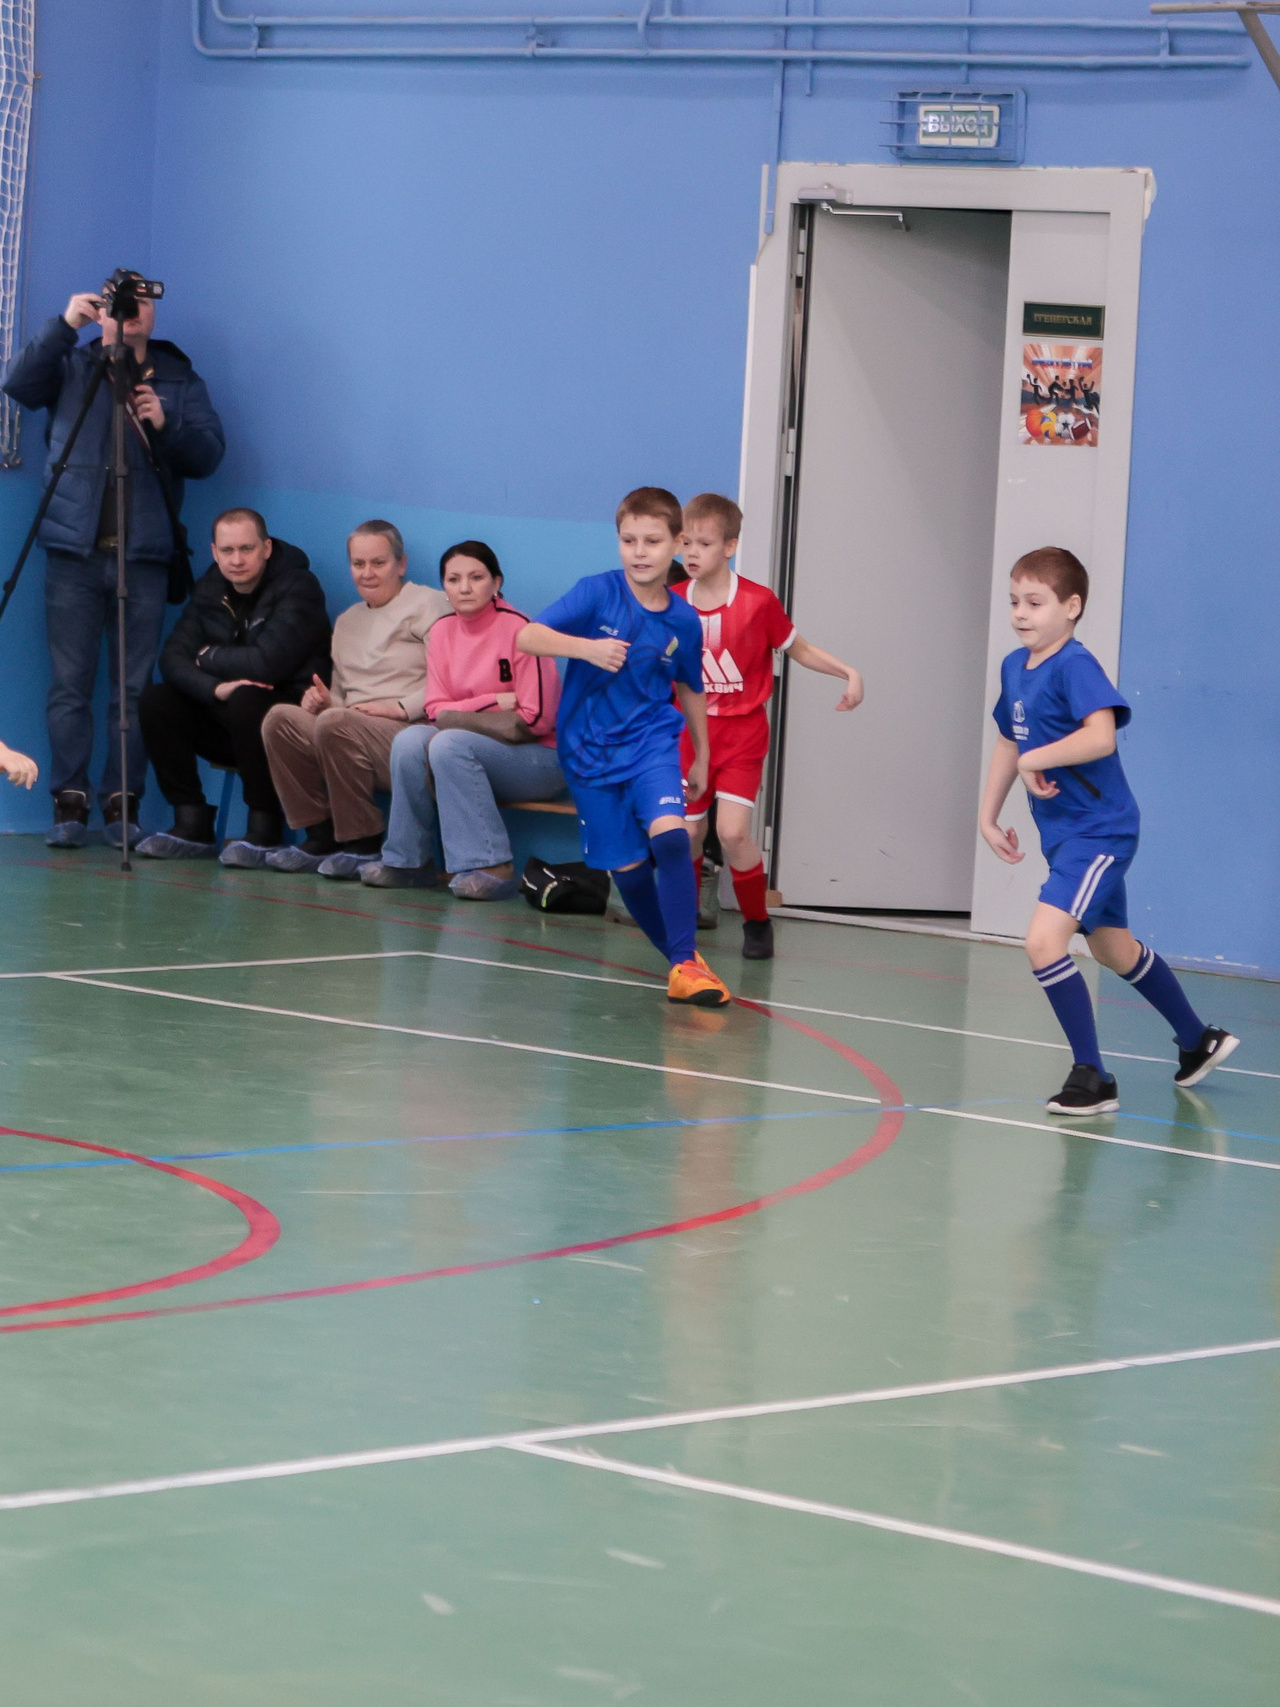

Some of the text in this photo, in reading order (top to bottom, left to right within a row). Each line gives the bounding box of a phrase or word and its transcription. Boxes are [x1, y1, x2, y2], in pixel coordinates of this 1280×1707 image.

[927, 114, 989, 136] ВЫХОД
[498, 658, 513, 683] B
[703, 683, 744, 694] КВИЧ
